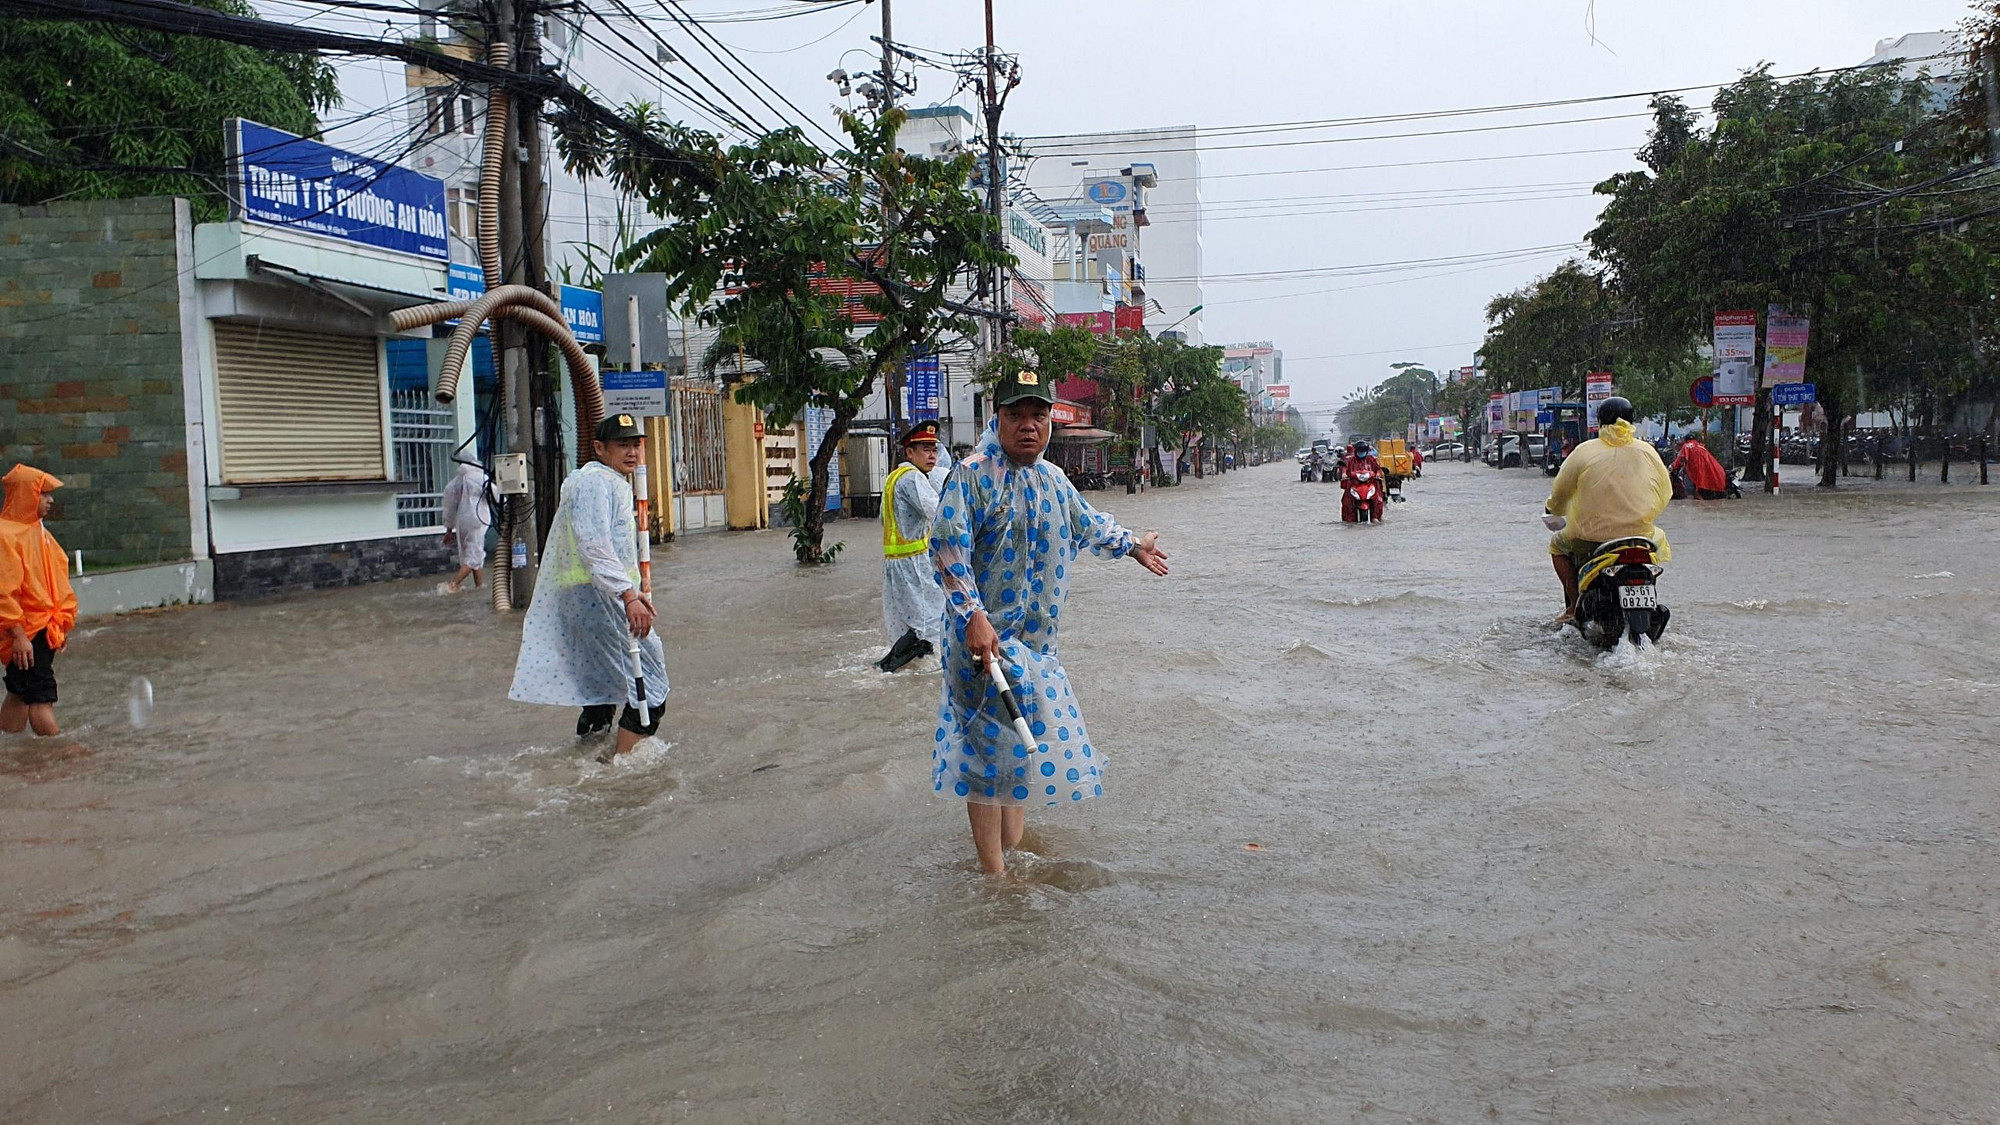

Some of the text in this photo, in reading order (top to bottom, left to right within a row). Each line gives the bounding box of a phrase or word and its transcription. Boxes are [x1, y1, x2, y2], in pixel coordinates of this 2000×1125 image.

[248, 165, 298, 209] TRẠM
[300, 178, 311, 209] Y
[314, 176, 334, 215] TẾ
[336, 187, 395, 229] PHƯỜNG
[397, 202, 417, 234] AN
[418, 203, 446, 240] HÒA
[1089, 234, 1128, 253] QUANG
[578, 307, 598, 328] HÒA
[1622, 597, 1656, 608] 082.25
